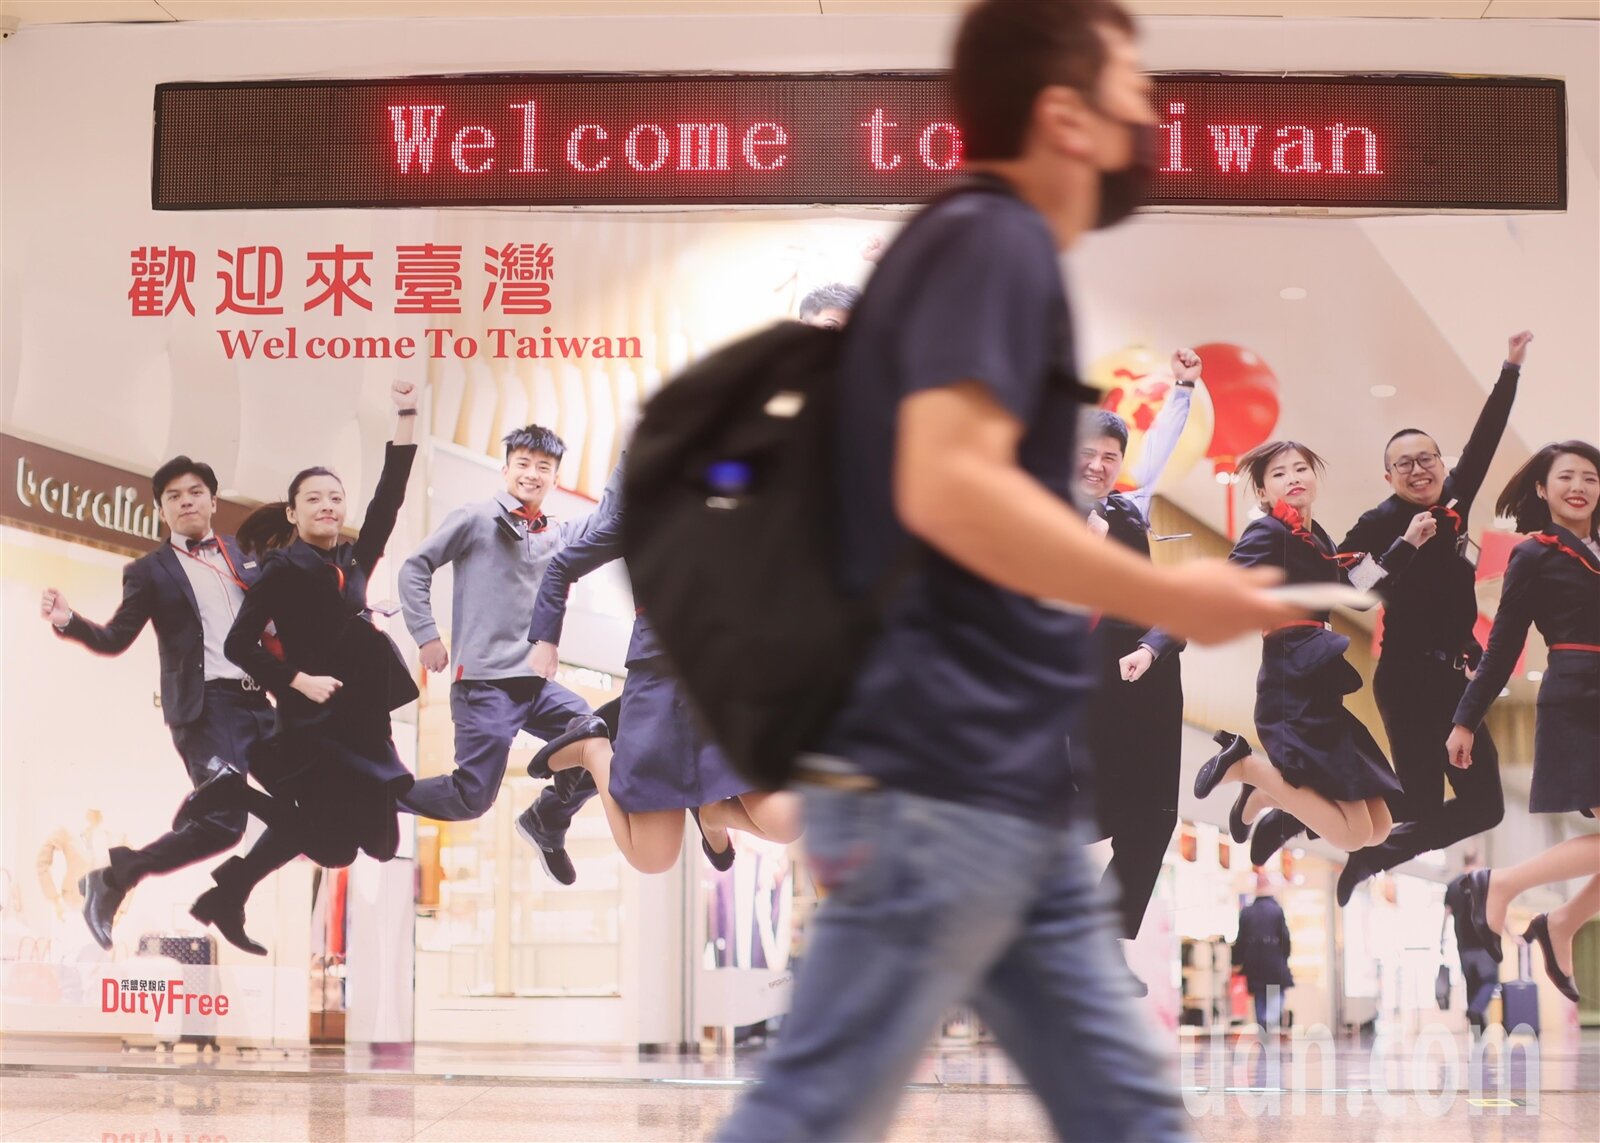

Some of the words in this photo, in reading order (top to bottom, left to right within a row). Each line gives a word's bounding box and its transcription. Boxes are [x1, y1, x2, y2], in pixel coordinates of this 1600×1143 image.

[387, 100, 788, 174] Welcome
[860, 107, 963, 170] to
[1159, 102, 1384, 174] iwan
[127, 242, 554, 317] 歡迎來臺灣
[216, 326, 416, 360] Welcome
[424, 327, 478, 360] To
[486, 326, 643, 360] Taiwan
[102, 978, 229, 1023] DutyFree
